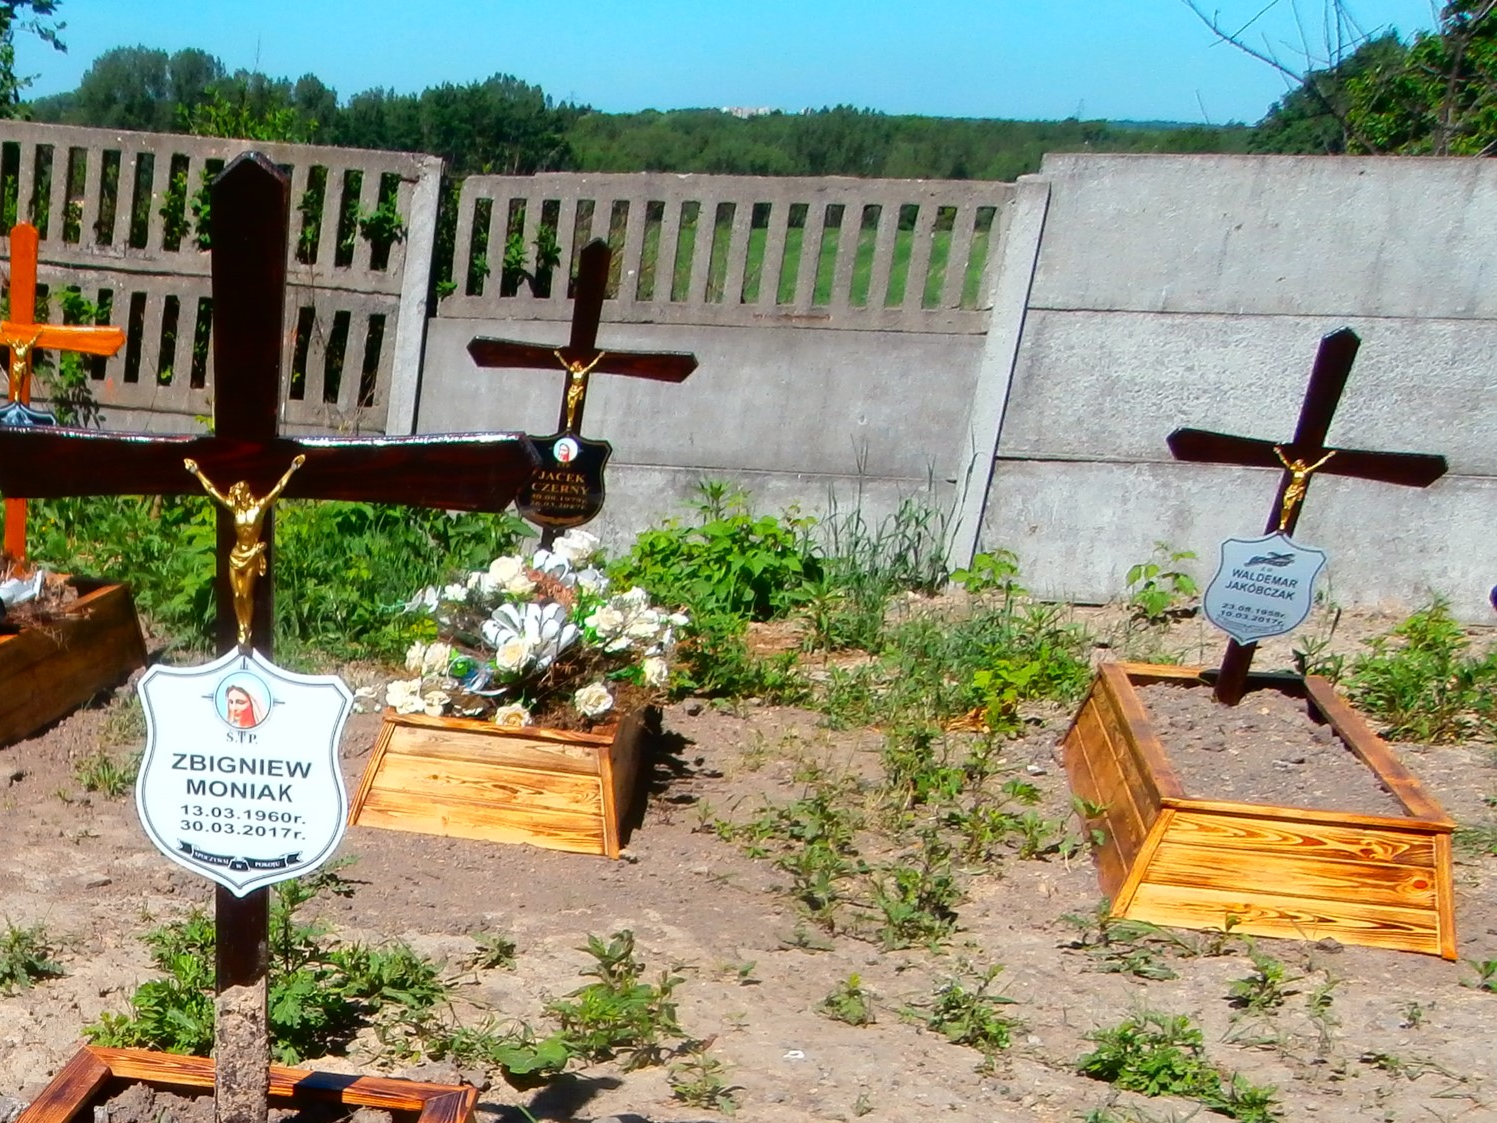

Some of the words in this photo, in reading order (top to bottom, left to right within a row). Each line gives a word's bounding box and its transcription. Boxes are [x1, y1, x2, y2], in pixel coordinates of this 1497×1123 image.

[538, 471, 585, 483] JACEK
[532, 483, 590, 496] CZERNY
[1232, 569, 1298, 588] WALDEMAR
[1225, 580, 1295, 600] JAKÓBCZAK
[171, 753, 313, 779] ZBIGNIEW
[186, 778, 294, 803] MONIAK
[180, 804, 306, 825] 13.03.1960r.
[180, 819, 306, 841] 30.03.2017r.
